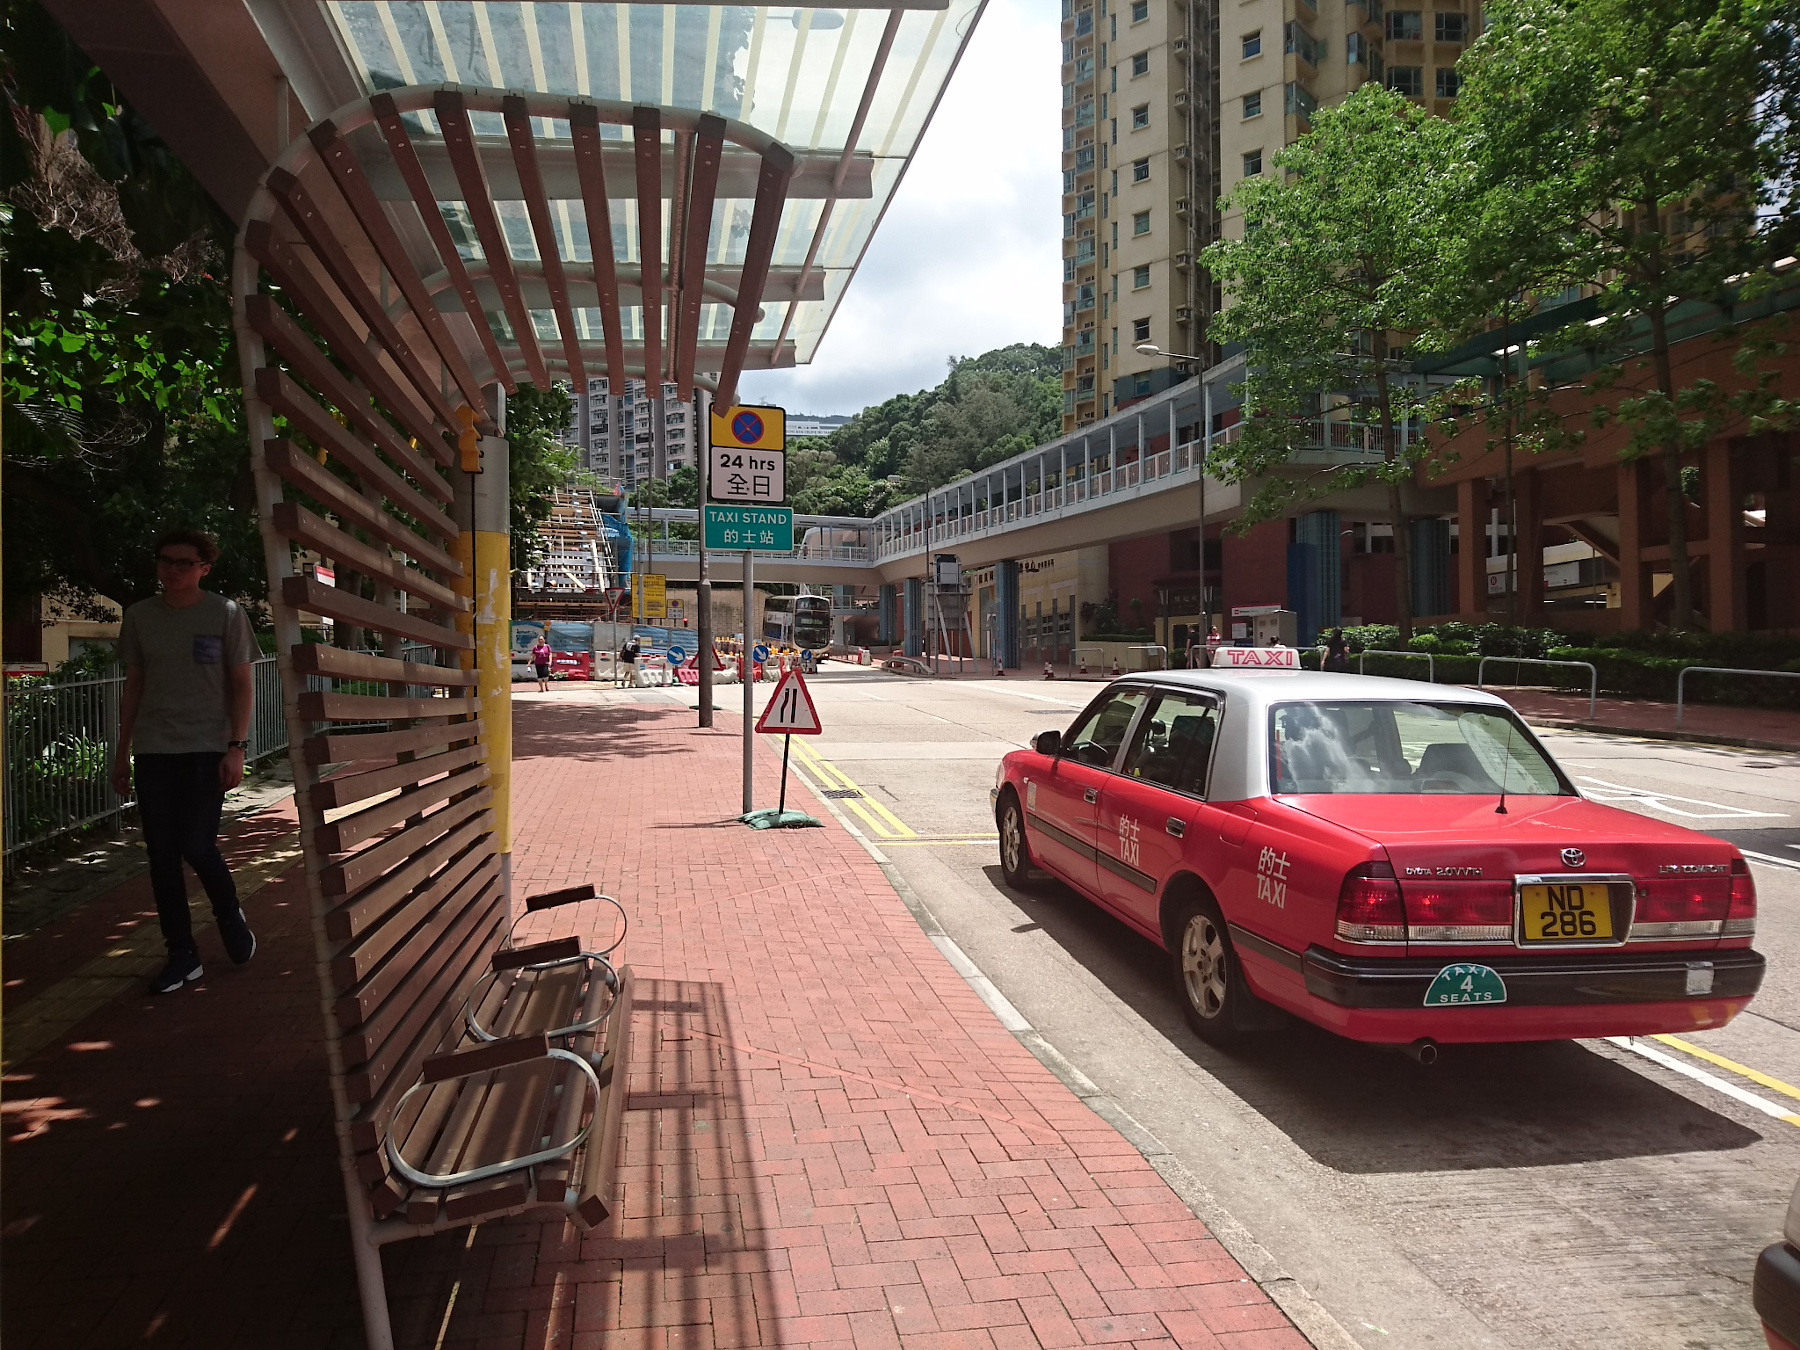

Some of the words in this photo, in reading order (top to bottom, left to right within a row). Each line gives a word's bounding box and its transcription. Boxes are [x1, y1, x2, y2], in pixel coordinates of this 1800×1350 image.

[720, 454, 743, 468] 24
[749, 456, 775, 471] hrs
[727, 473, 770, 496] 全日
[709, 511, 739, 523] TAXI
[742, 512, 787, 525] STAND
[724, 529, 774, 544] 的士站
[1227, 650, 1293, 666] TAXI
[1119, 813, 1140, 842] 的士
[1118, 835, 1140, 867] TAXI
[1257, 845, 1291, 881] 的士
[1256, 873, 1287, 909] TAXI
[1547, 885, 1585, 911] ND
[1540, 910, 1597, 937] 286
[1441, 965, 1488, 981] TAXI
[1460, 974, 1474, 992] 4
[1440, 991, 1493, 1003] SEATS
